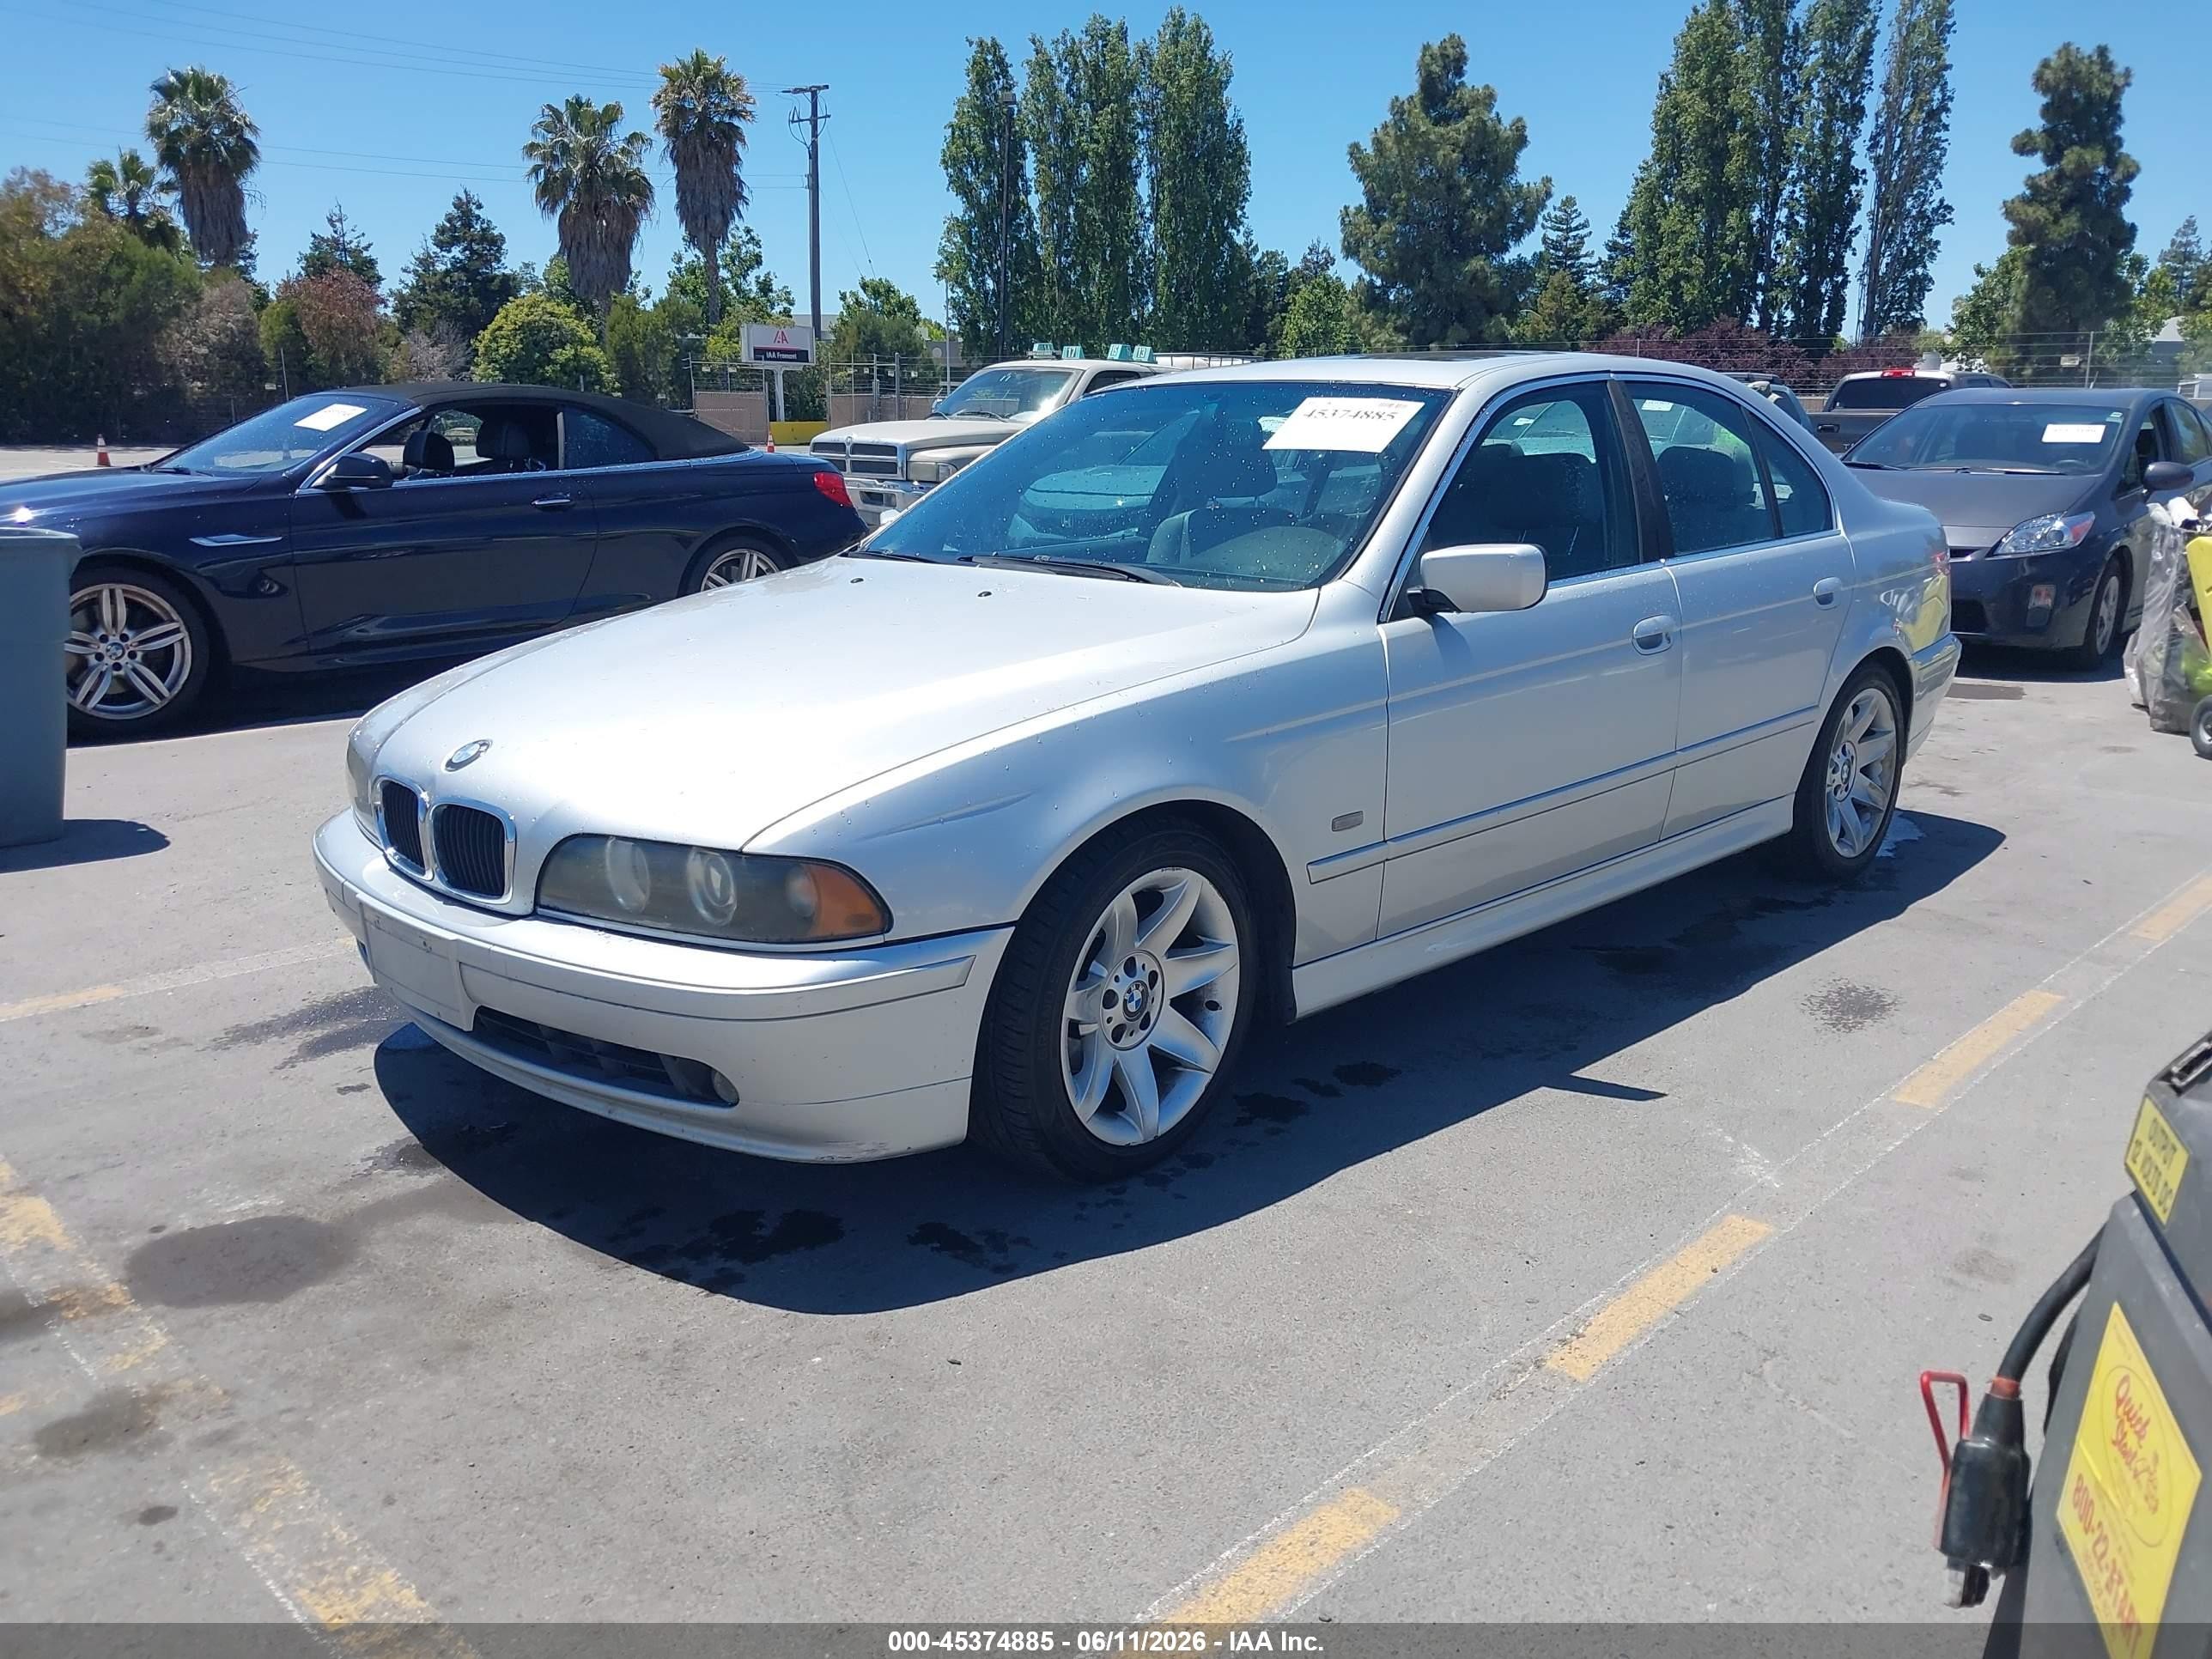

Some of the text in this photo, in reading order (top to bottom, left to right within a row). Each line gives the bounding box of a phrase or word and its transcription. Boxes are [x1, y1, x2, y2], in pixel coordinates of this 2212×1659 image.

[1067, 346, 1077, 358] 17
[1110, 344, 1120, 356] 15
[1137, 348, 1147, 358] 13
[1304, 409, 1398, 420] 45374885
[2148, 1117, 2177, 1170] OUTPUT
[2115, 1374, 2150, 1449] Quick
